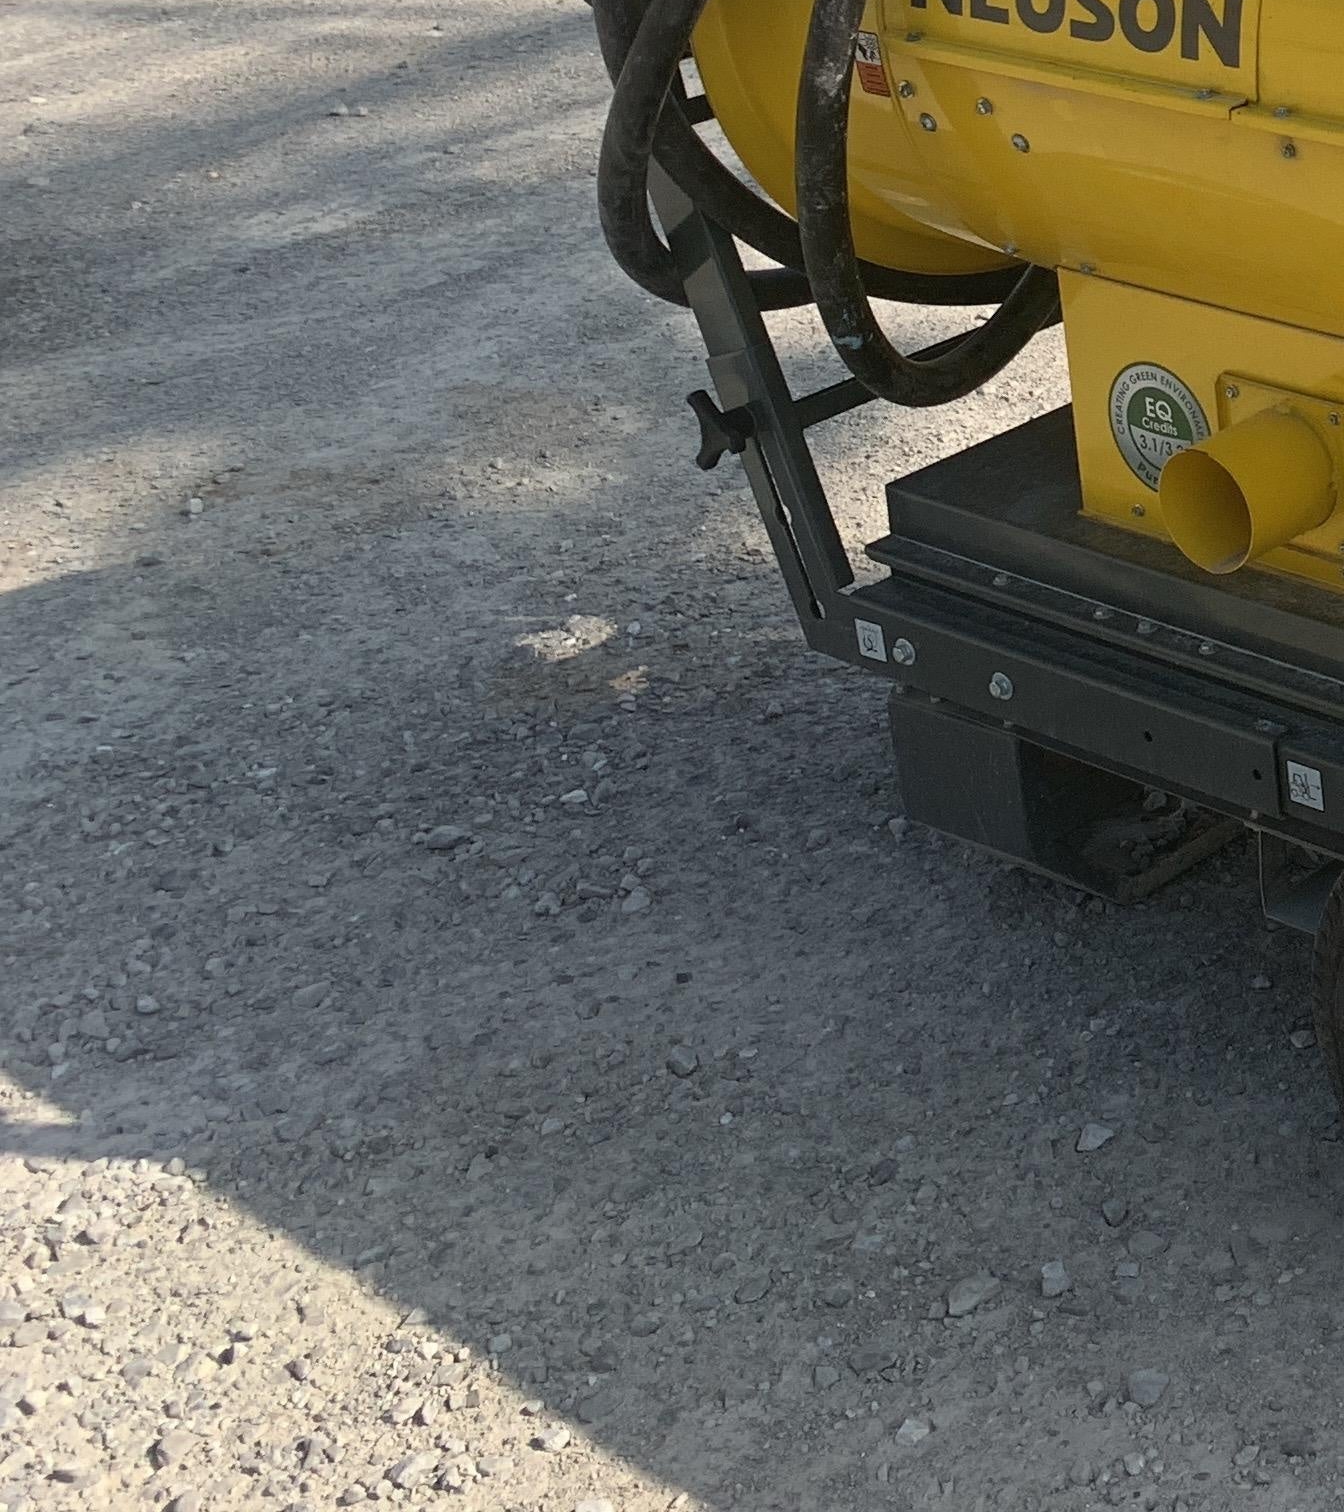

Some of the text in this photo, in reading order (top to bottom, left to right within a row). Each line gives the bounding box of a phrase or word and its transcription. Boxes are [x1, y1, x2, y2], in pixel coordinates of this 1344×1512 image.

[1116, 381, 1130, 435] CREATING
[1129, 371, 1158, 384] GREEN
[1144, 396, 1173, 423] EQ
[1141, 417, 1178, 436] Credits
